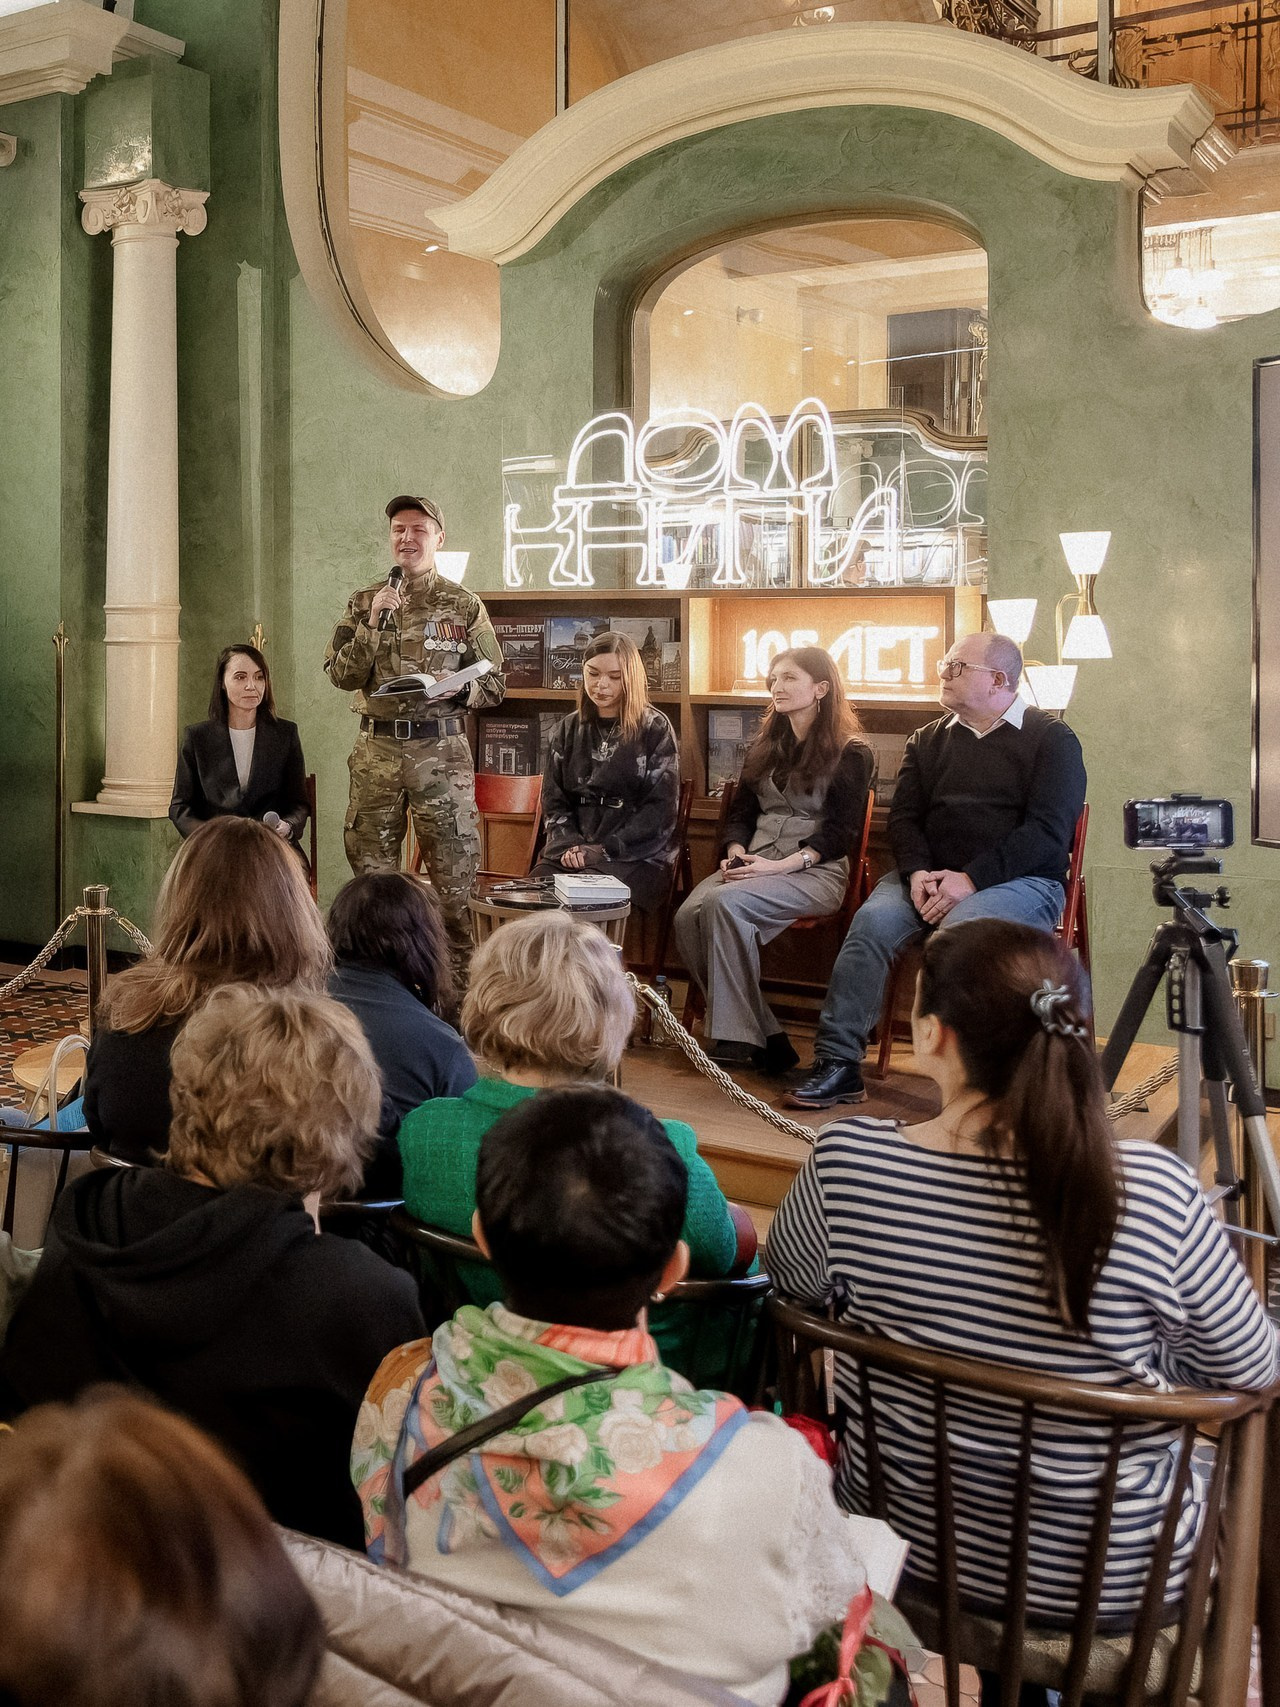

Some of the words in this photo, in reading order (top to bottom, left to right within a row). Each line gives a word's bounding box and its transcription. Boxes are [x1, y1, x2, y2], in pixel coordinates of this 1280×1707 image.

[554, 397, 838, 503] ДОМ
[504, 486, 897, 587] КНИГИ
[829, 625, 939, 682] ЛЕТ
